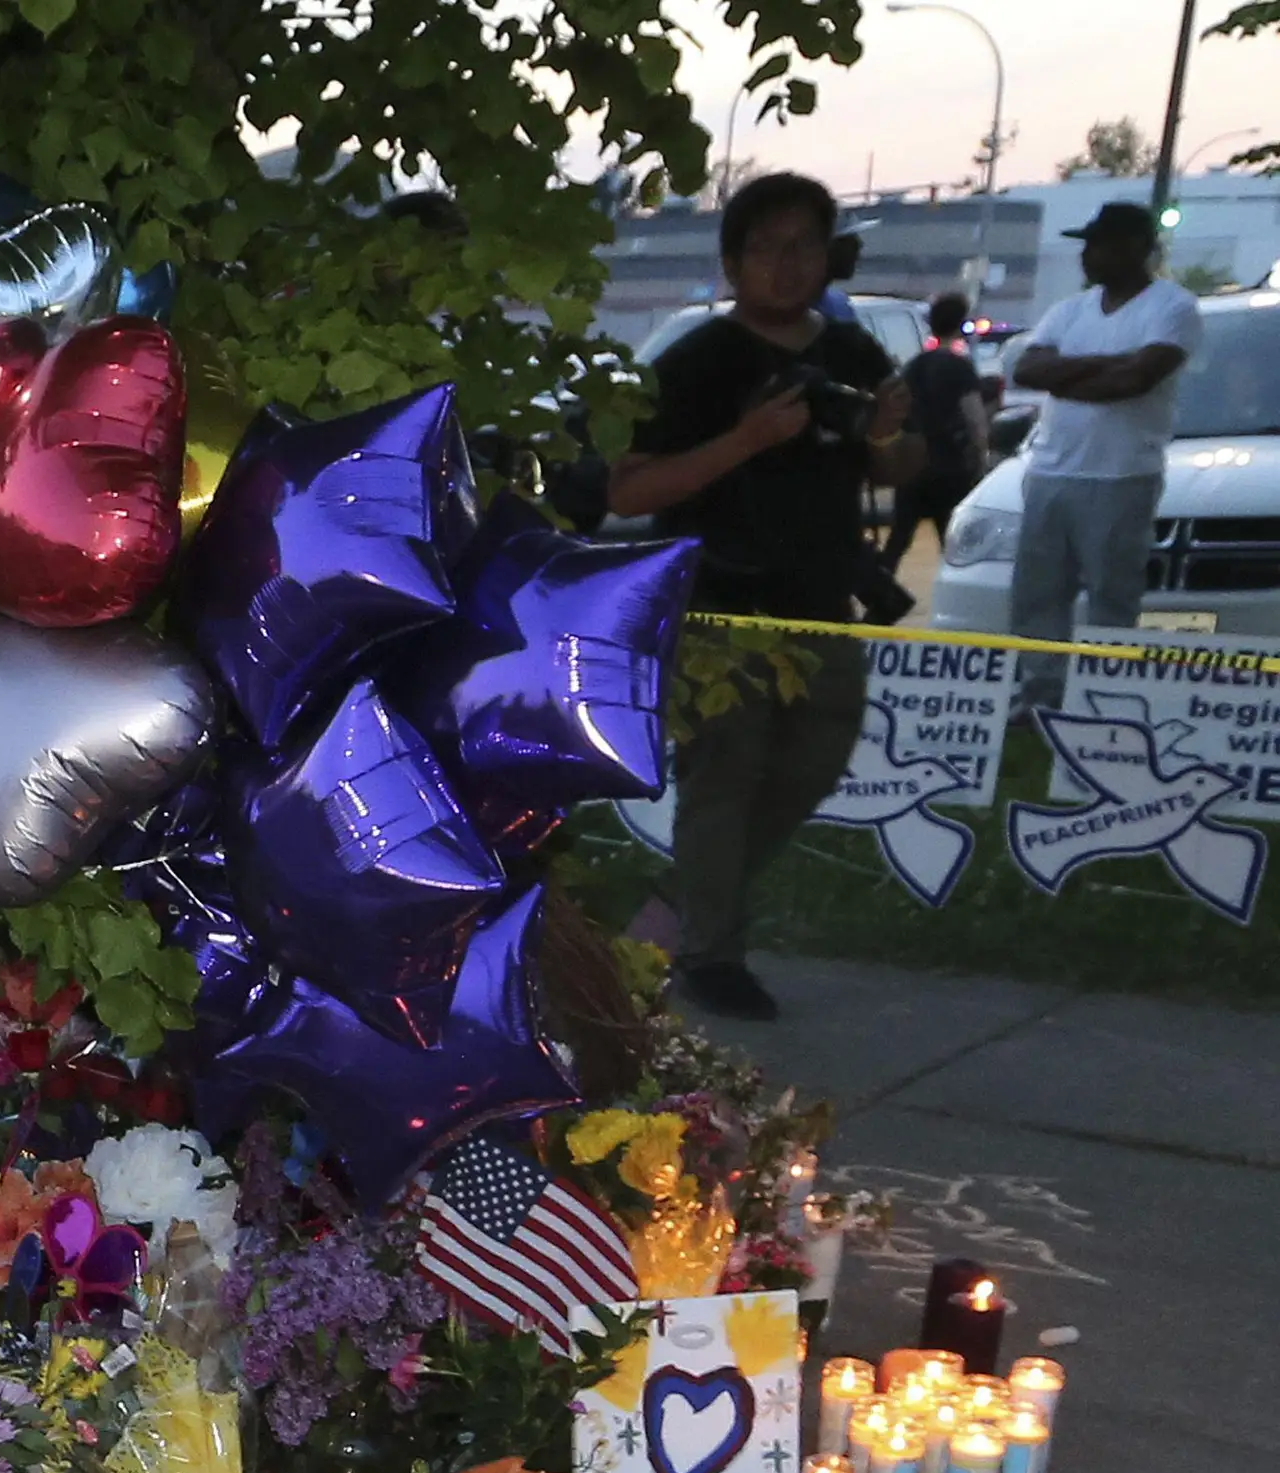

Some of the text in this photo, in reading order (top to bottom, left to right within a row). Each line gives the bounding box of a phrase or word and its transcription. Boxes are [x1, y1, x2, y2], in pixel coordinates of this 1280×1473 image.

[916, 721, 991, 745] with
[1077, 746, 1146, 765] Leave
[1023, 791, 1196, 850] PEACEPRINTS
